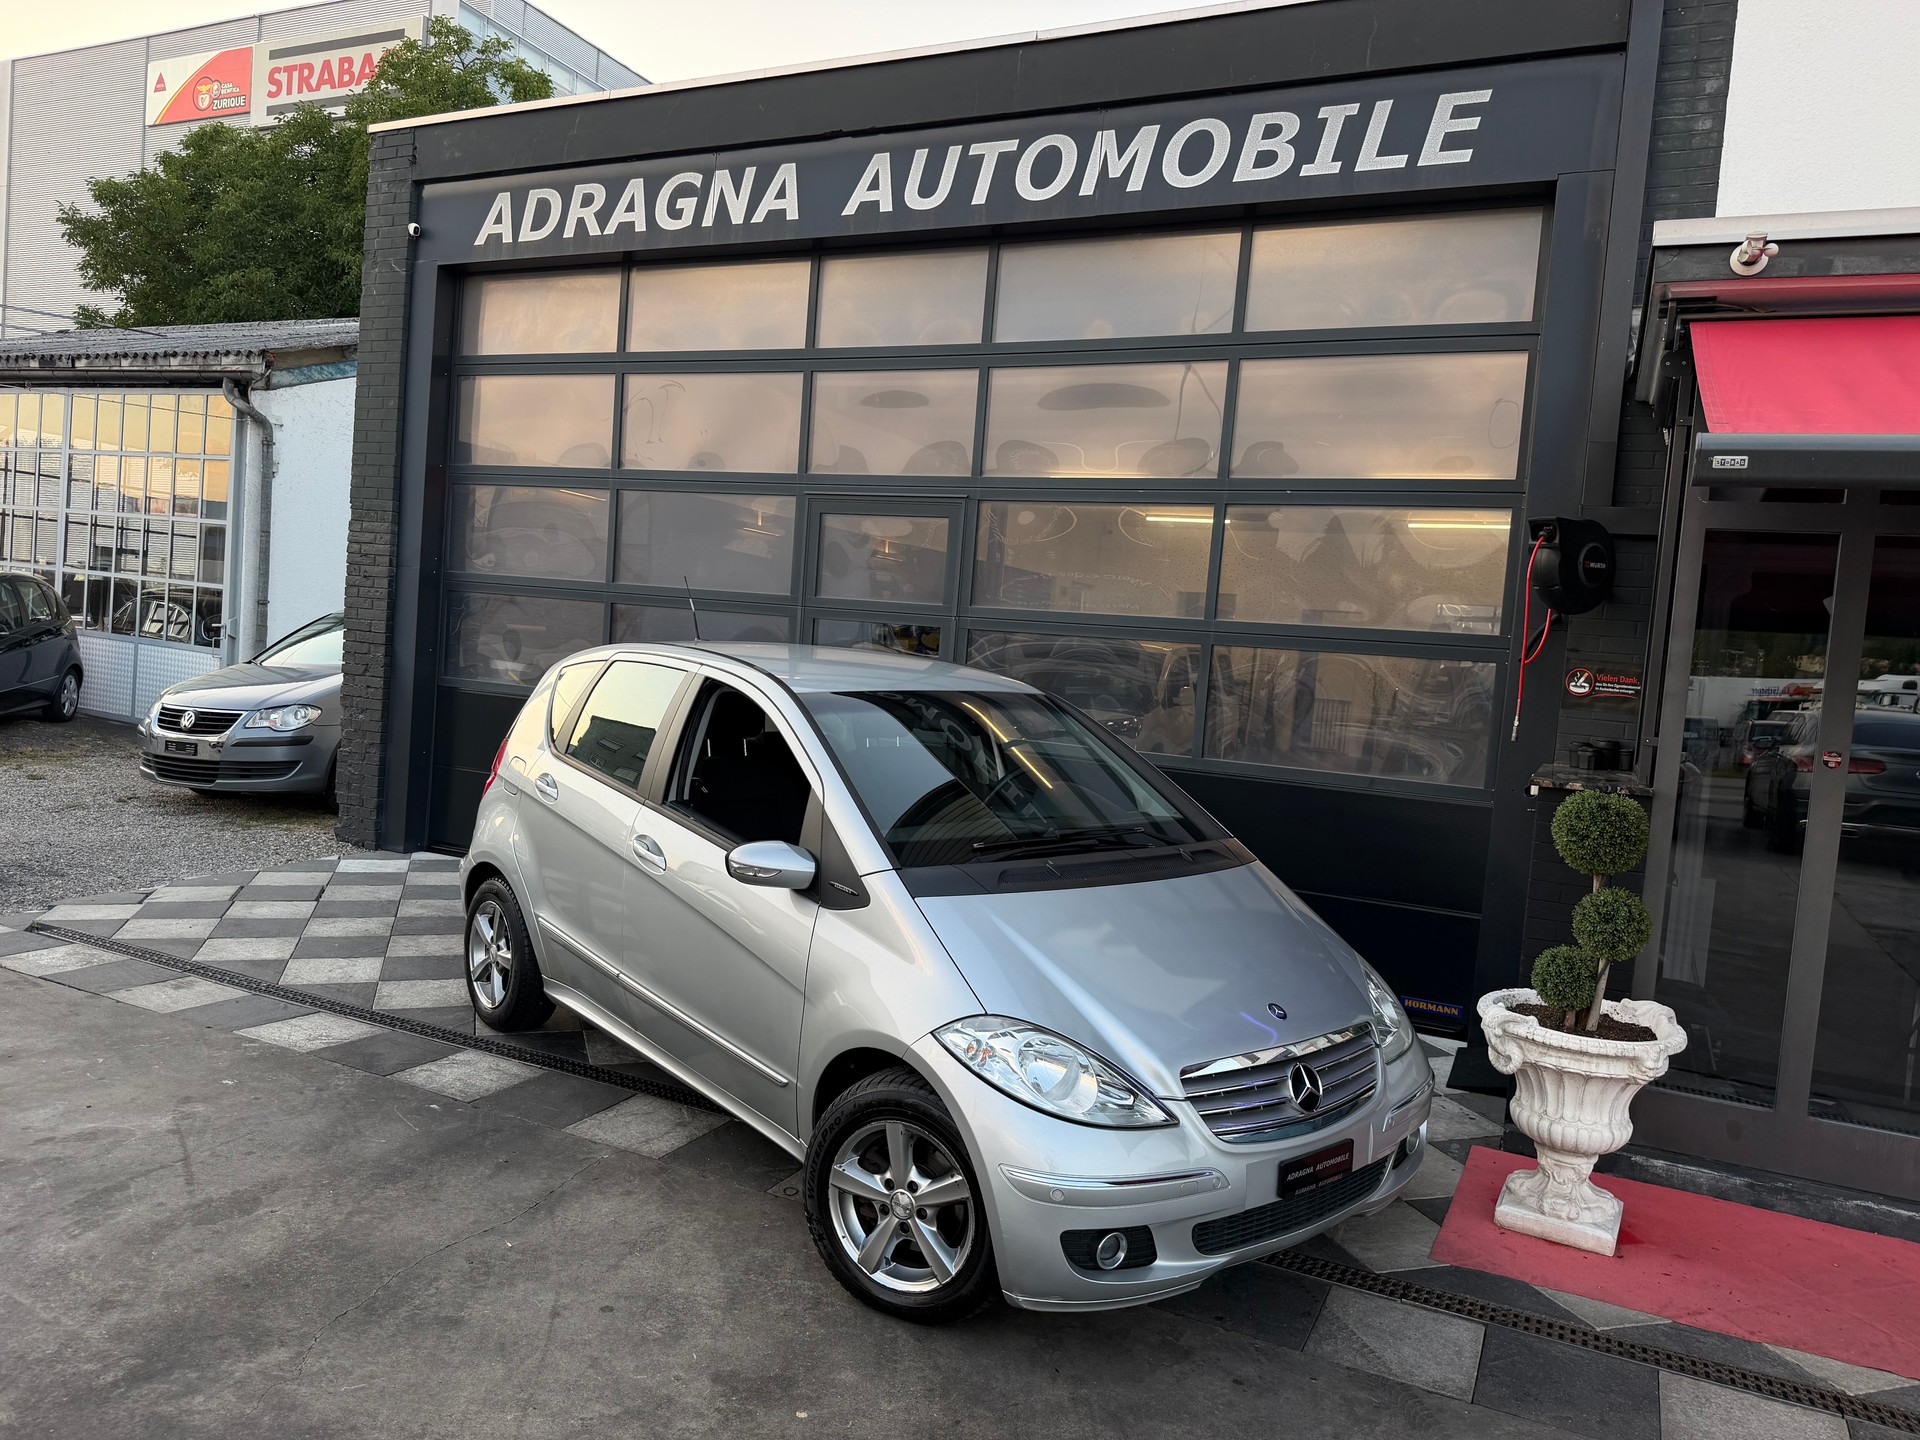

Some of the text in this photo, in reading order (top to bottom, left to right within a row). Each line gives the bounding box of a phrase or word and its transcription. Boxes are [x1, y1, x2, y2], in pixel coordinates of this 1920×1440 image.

[266, 48, 398, 98] STRABA
[212, 95, 246, 110] ZURIQUE
[474, 89, 1493, 246] ADRAGNA AUTOMOBILE
[1286, 1152, 1350, 1182] ADRAGNA AUTOMOBILE
